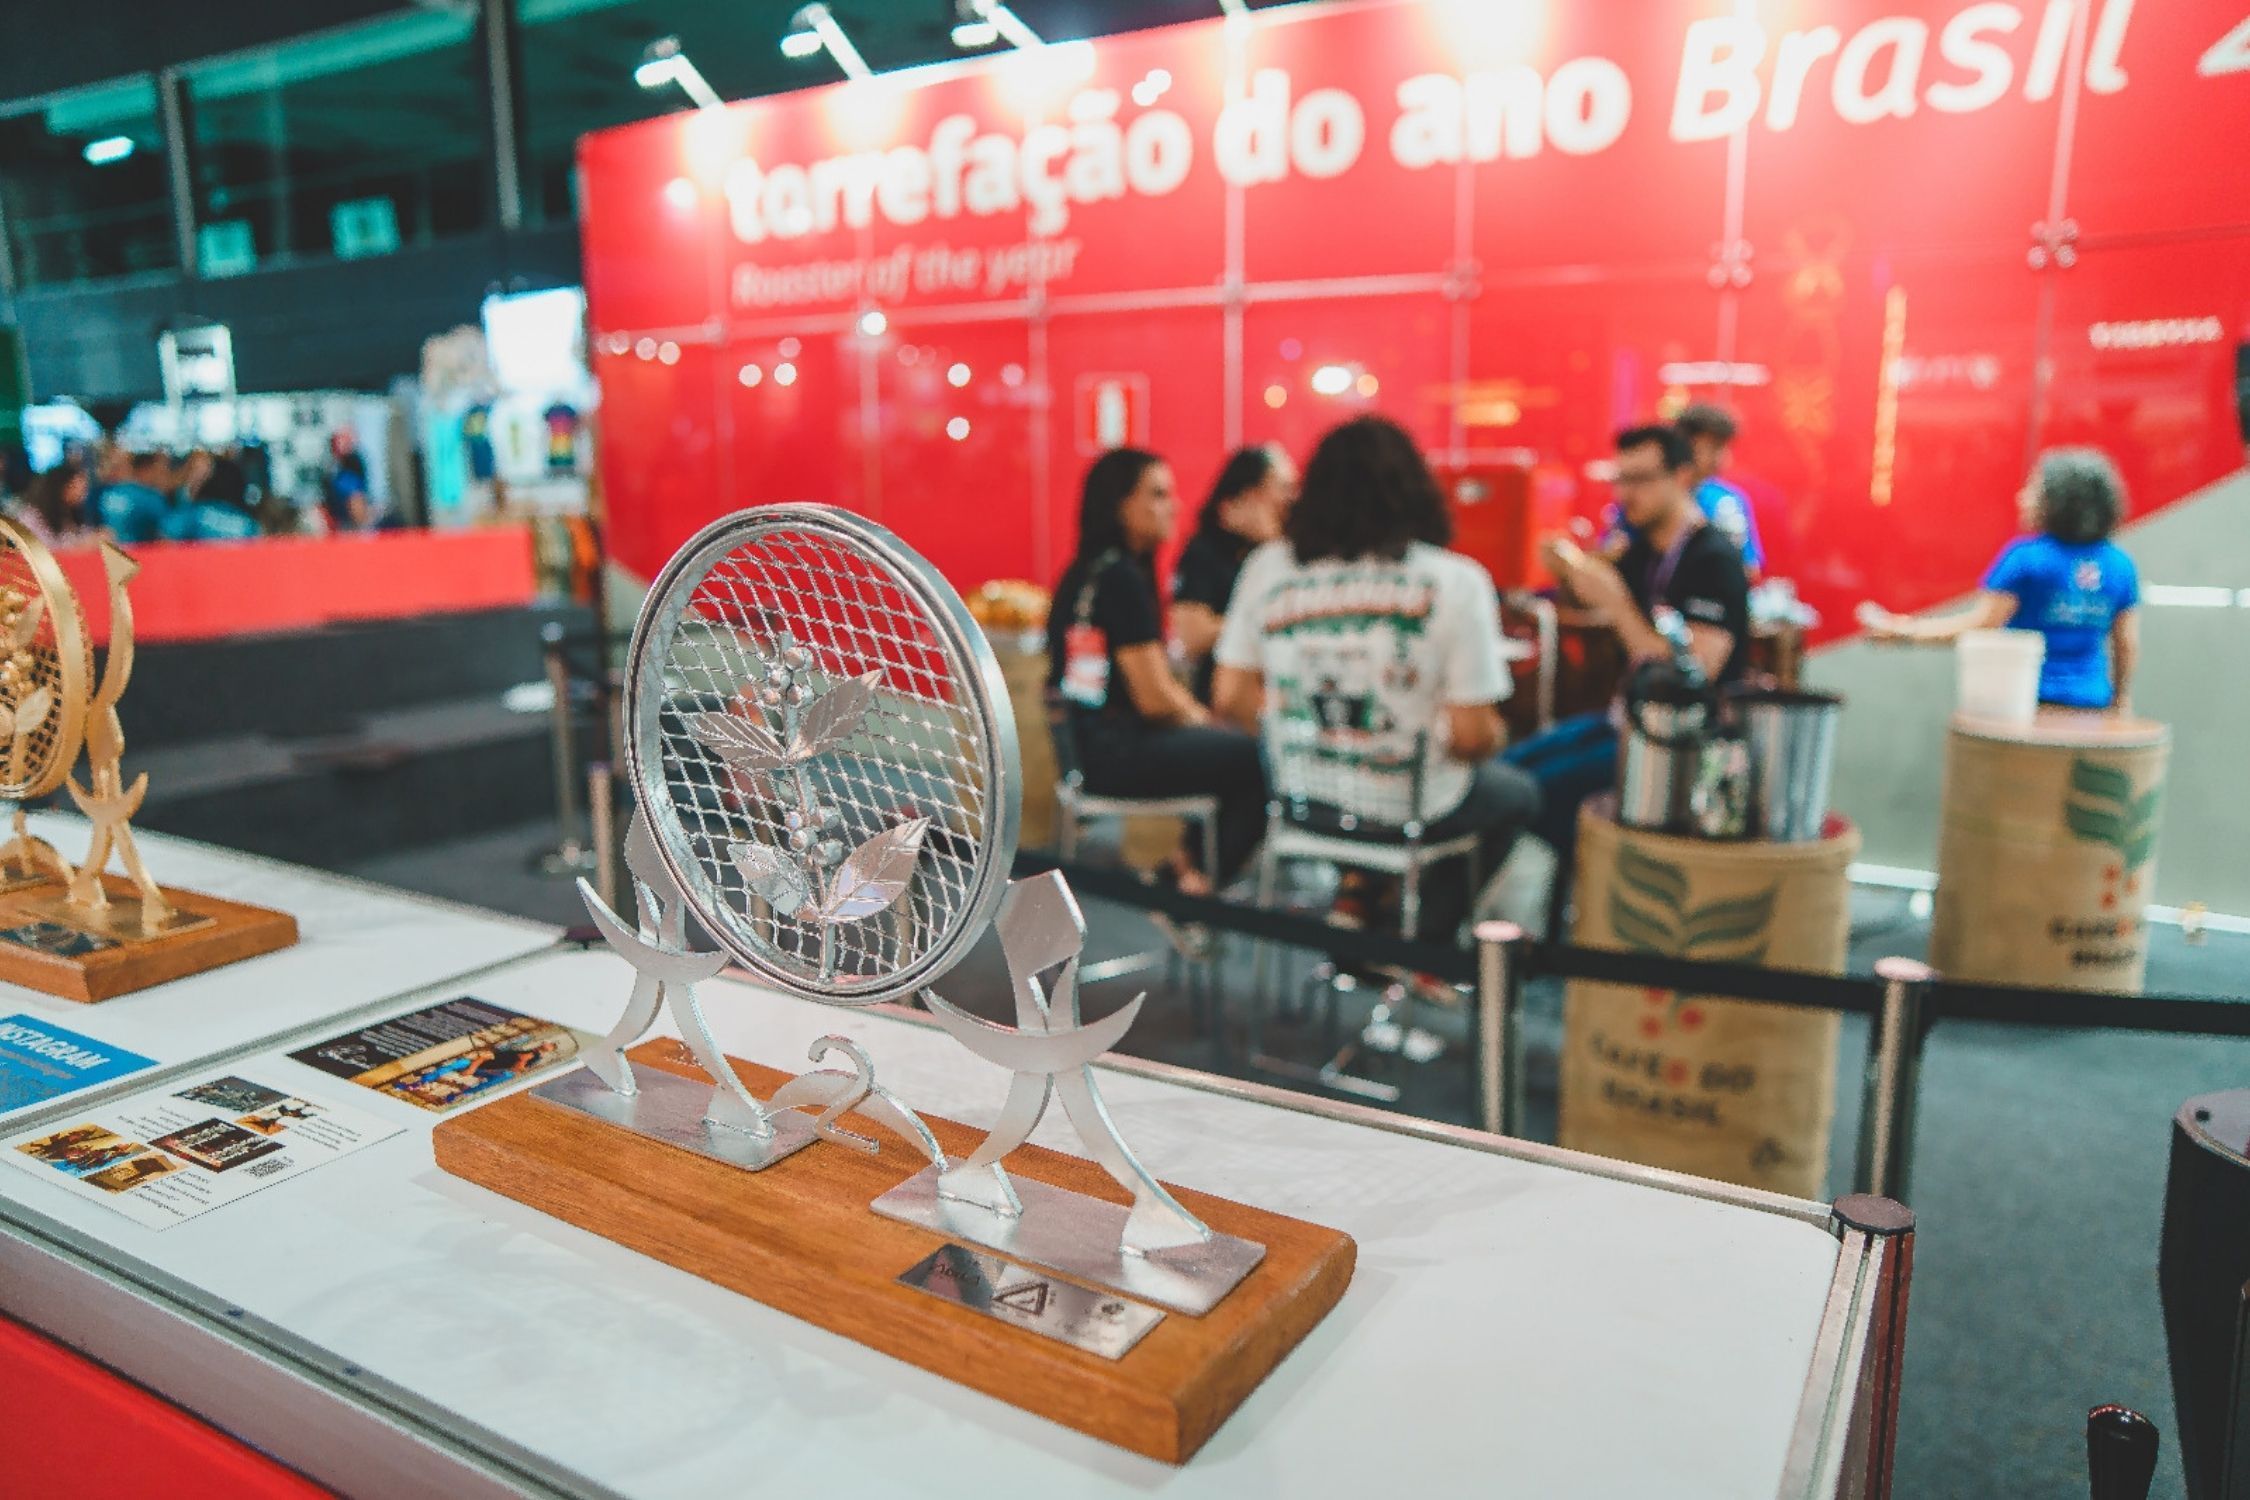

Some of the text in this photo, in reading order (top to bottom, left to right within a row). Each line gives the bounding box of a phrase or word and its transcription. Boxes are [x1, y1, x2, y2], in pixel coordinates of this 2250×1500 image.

[724, 94, 1193, 242] torrefação
[1213, 68, 1365, 186] do
[1390, 56, 1632, 169] ano
[1669, 0, 2134, 142] Brasil
